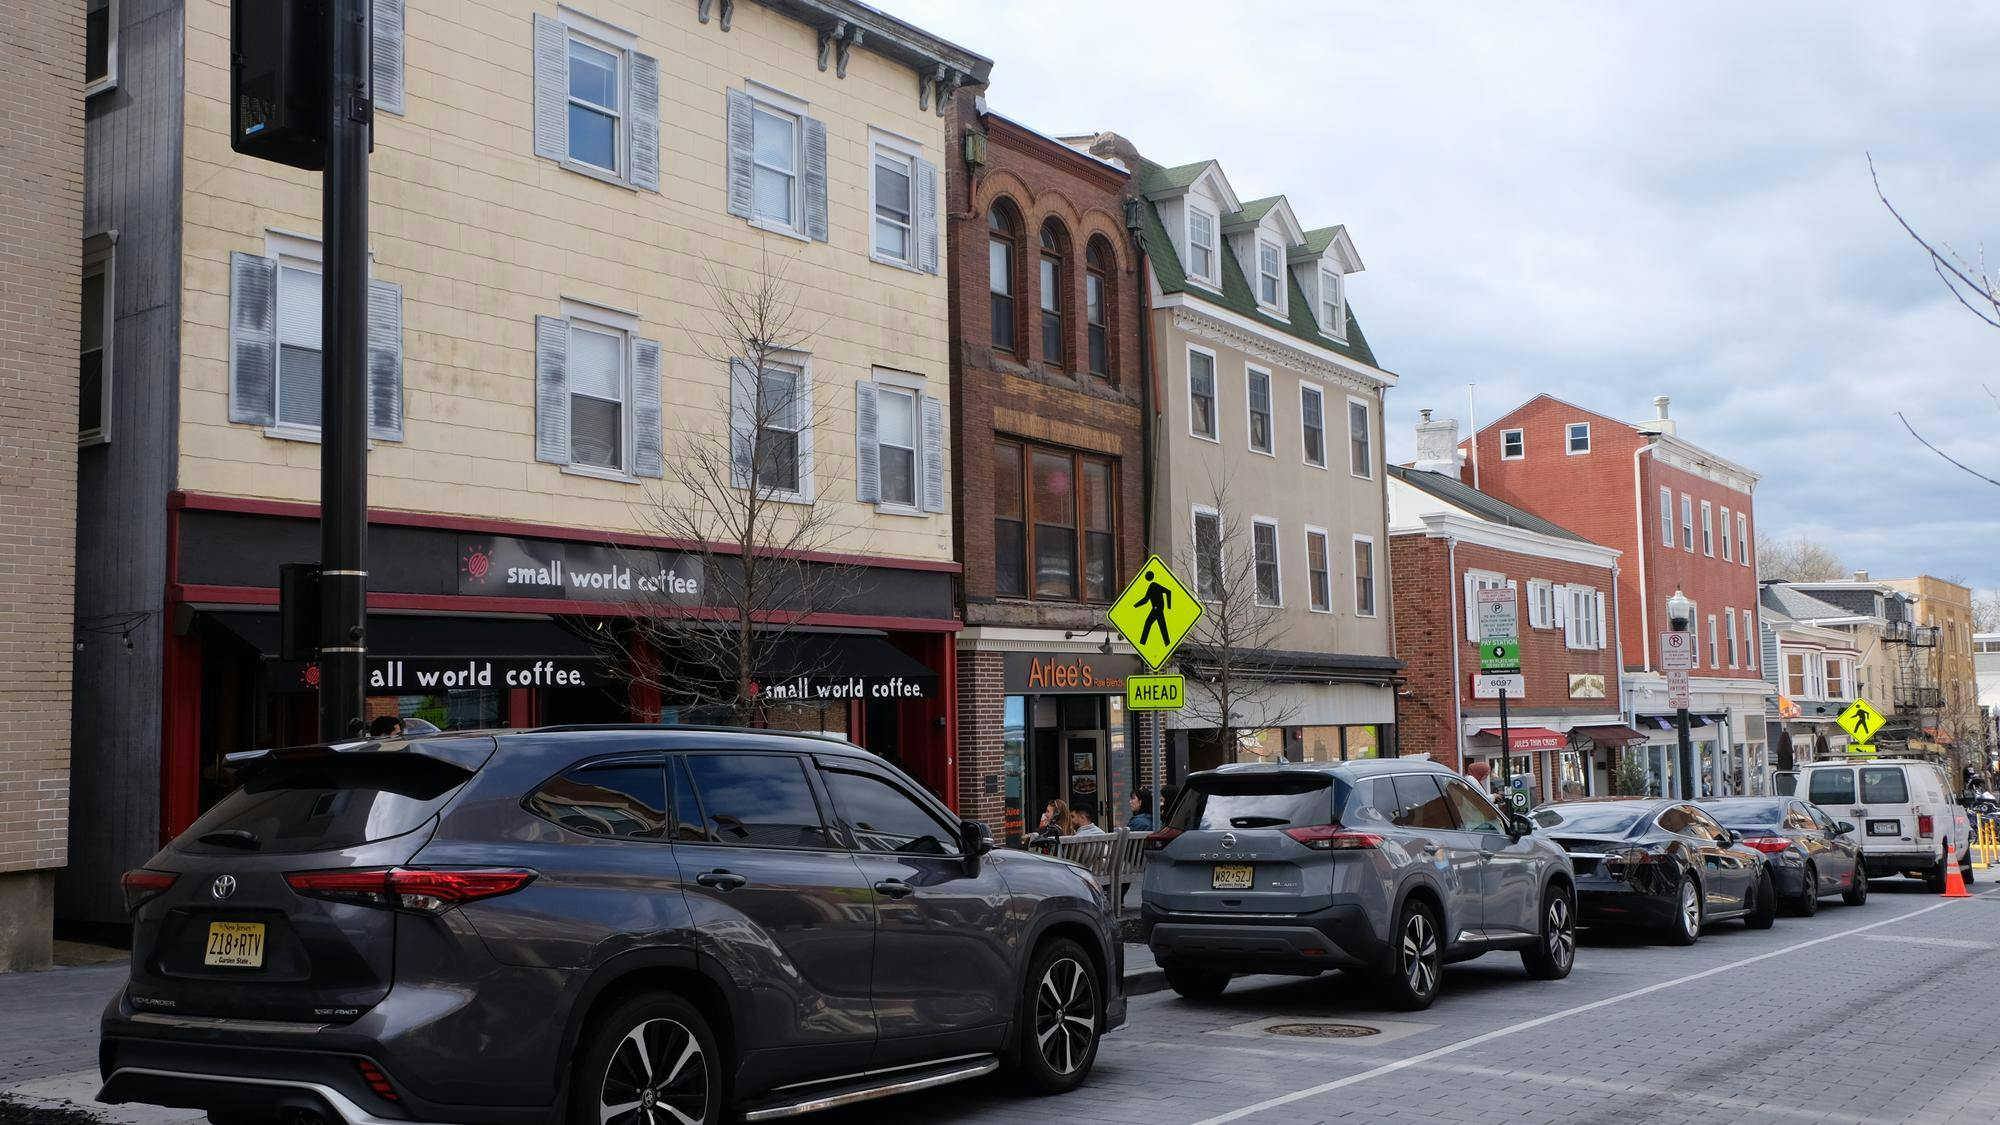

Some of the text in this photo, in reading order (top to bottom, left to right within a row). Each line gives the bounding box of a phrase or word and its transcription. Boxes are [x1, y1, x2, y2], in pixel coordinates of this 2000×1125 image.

[507, 561, 697, 594] small world coffee
[370, 660, 403, 687] all
[416, 660, 492, 687] world
[1028, 656, 1092, 688] Arlee's
[765, 677, 808, 699] small
[816, 677, 864, 698] world
[1134, 684, 1177, 701] AHEAD
[1514, 738, 1558, 748] JULES THIN CRUST
